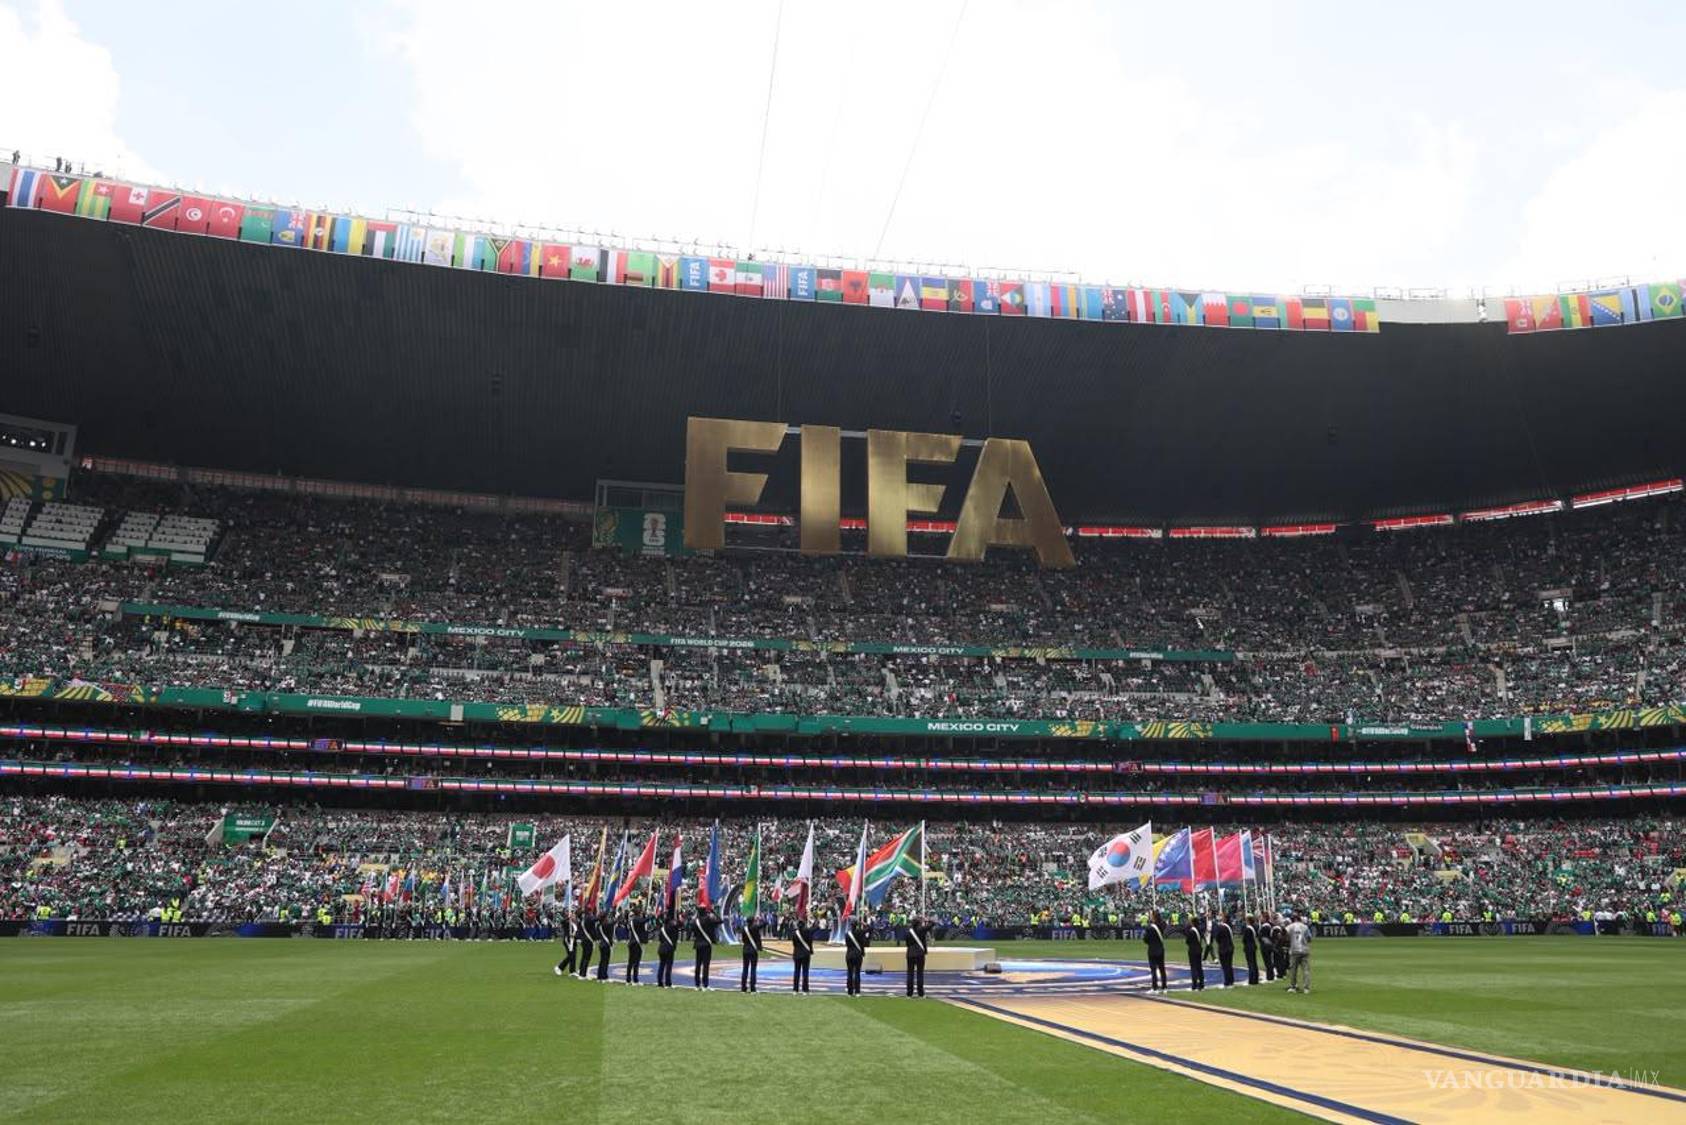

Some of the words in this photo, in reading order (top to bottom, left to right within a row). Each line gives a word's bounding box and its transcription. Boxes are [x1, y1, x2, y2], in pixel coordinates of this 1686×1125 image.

[690, 262, 701, 286] FIFA
[798, 270, 809, 297] FIFA
[683, 416, 1077, 569] FIFA
[447, 626, 495, 636] MEXICO
[497, 628, 525, 637] CITY
[893, 646, 936, 654] MEXICO
[938, 647, 964, 655] CITY
[927, 722, 984, 731] MEXICO
[986, 723, 1019, 732] CITY
[66, 923, 100, 936] FIFA
[158, 924, 191, 937] FIFA
[1323, 926, 1347, 937] FIFA
[1449, 924, 1473, 935] FIFA
[1512, 923, 1536, 934] FIFA
[1052, 930, 1077, 940] FIFA
